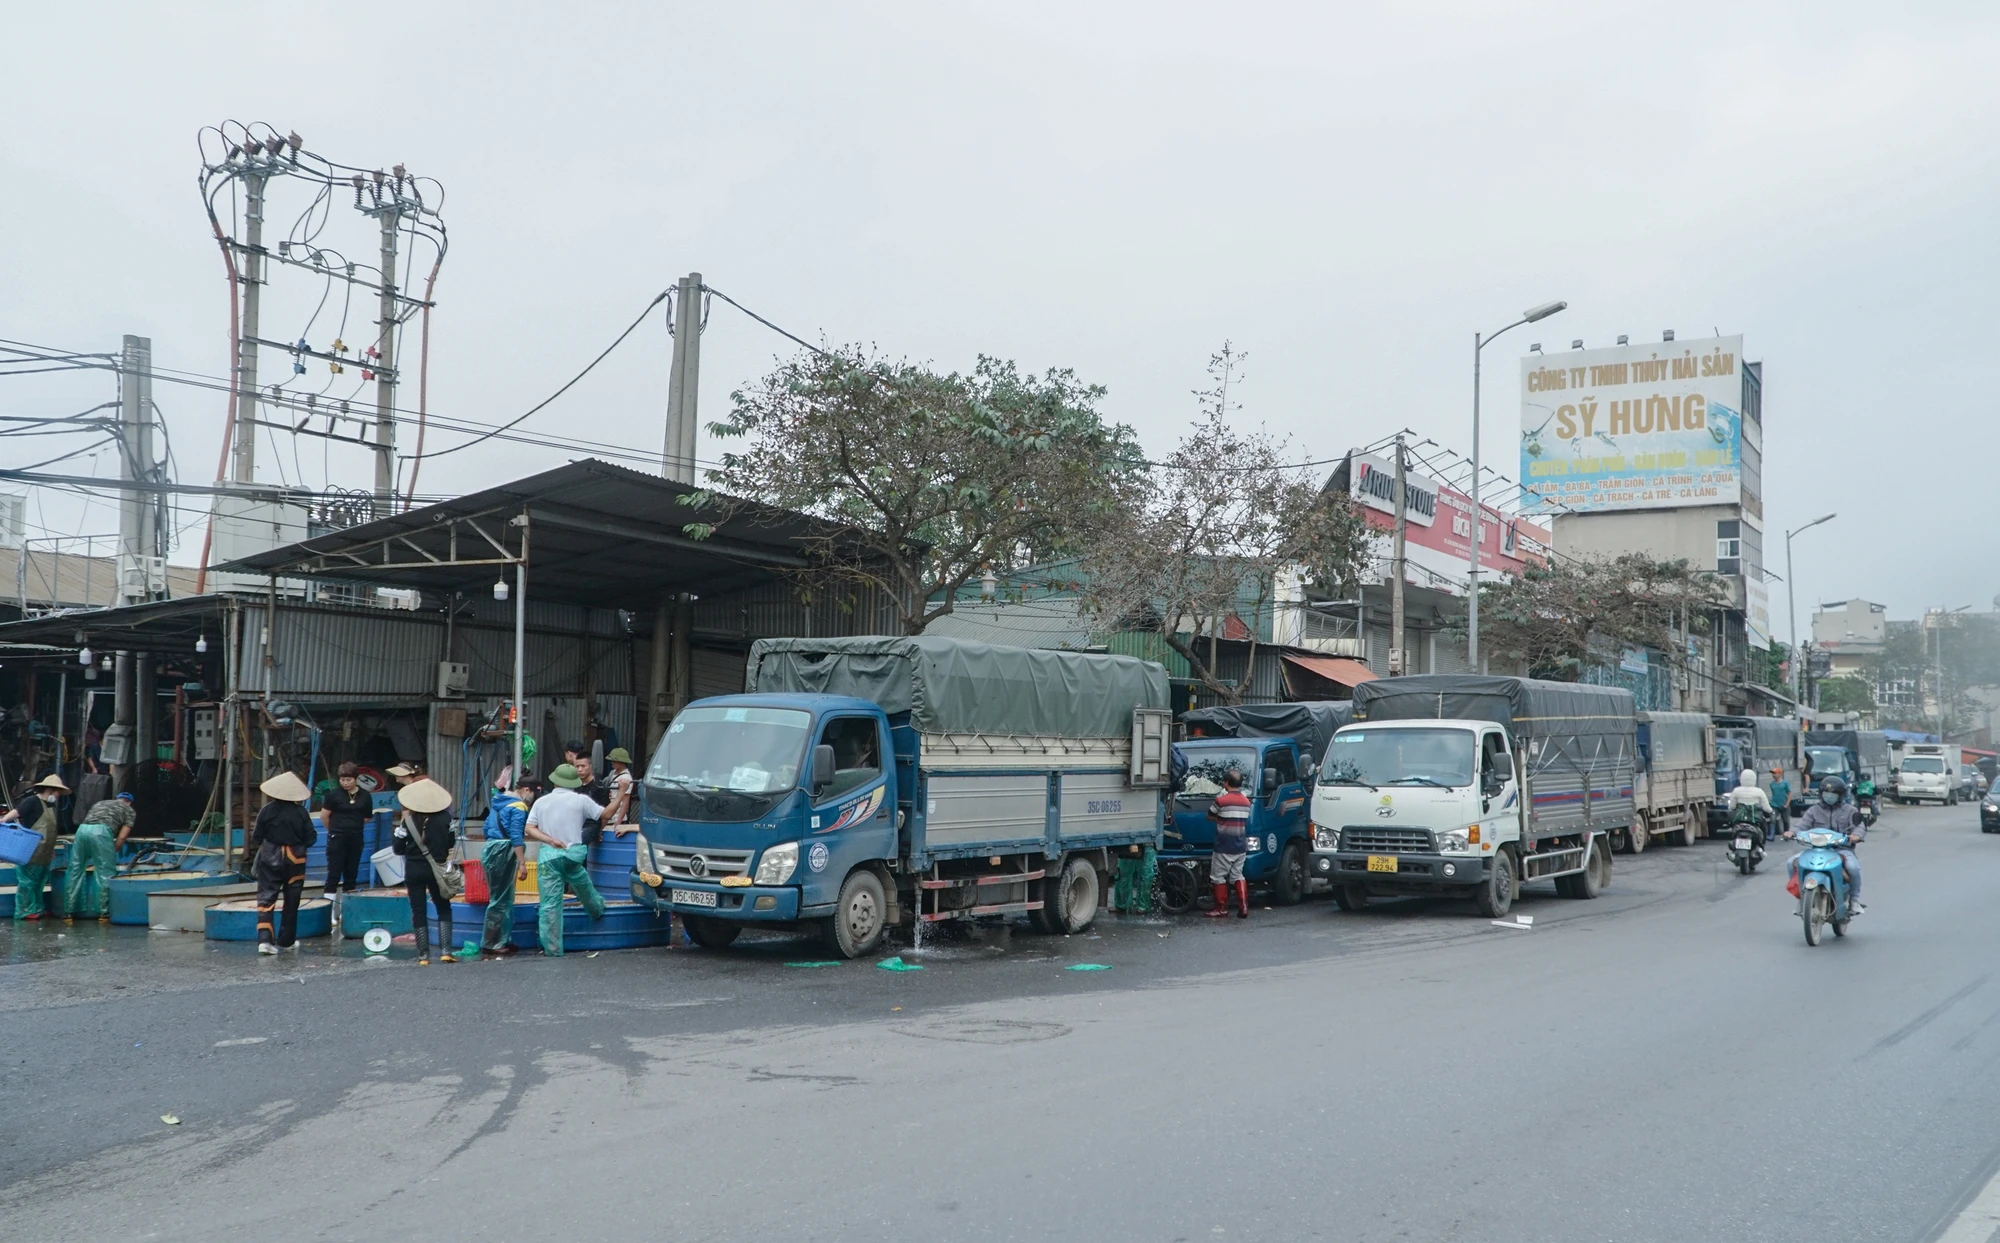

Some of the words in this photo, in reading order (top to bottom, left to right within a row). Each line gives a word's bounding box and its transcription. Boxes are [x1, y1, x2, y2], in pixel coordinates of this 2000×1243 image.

[1527, 366, 1567, 393] CÔNG
[1569, 366, 1587, 389] TY
[1590, 363, 1628, 387] TNHH
[1630, 353, 1669, 384] THỦY
[1671, 349, 1698, 380] HẢI
[1701, 346, 1734, 377] SẢN
[1556, 395, 1599, 440] SỸ
[1610, 393, 1705, 436] HƯNG
[1359, 464, 1437, 518] BRIDSTONE
[1565, 481, 1577, 492] BA
[1579, 481, 1591, 491] BA
[1653, 475, 1665, 487] CÁ
[1701, 471, 1713, 484] CÁ
[1593, 490, 1605, 503] CÁ
[1642, 489, 1654, 501] CÁ
[1680, 486, 1692, 498] CÁ
[753, 822, 776, 831] OLLIN
[1376, 856, 1389, 864] 29H
